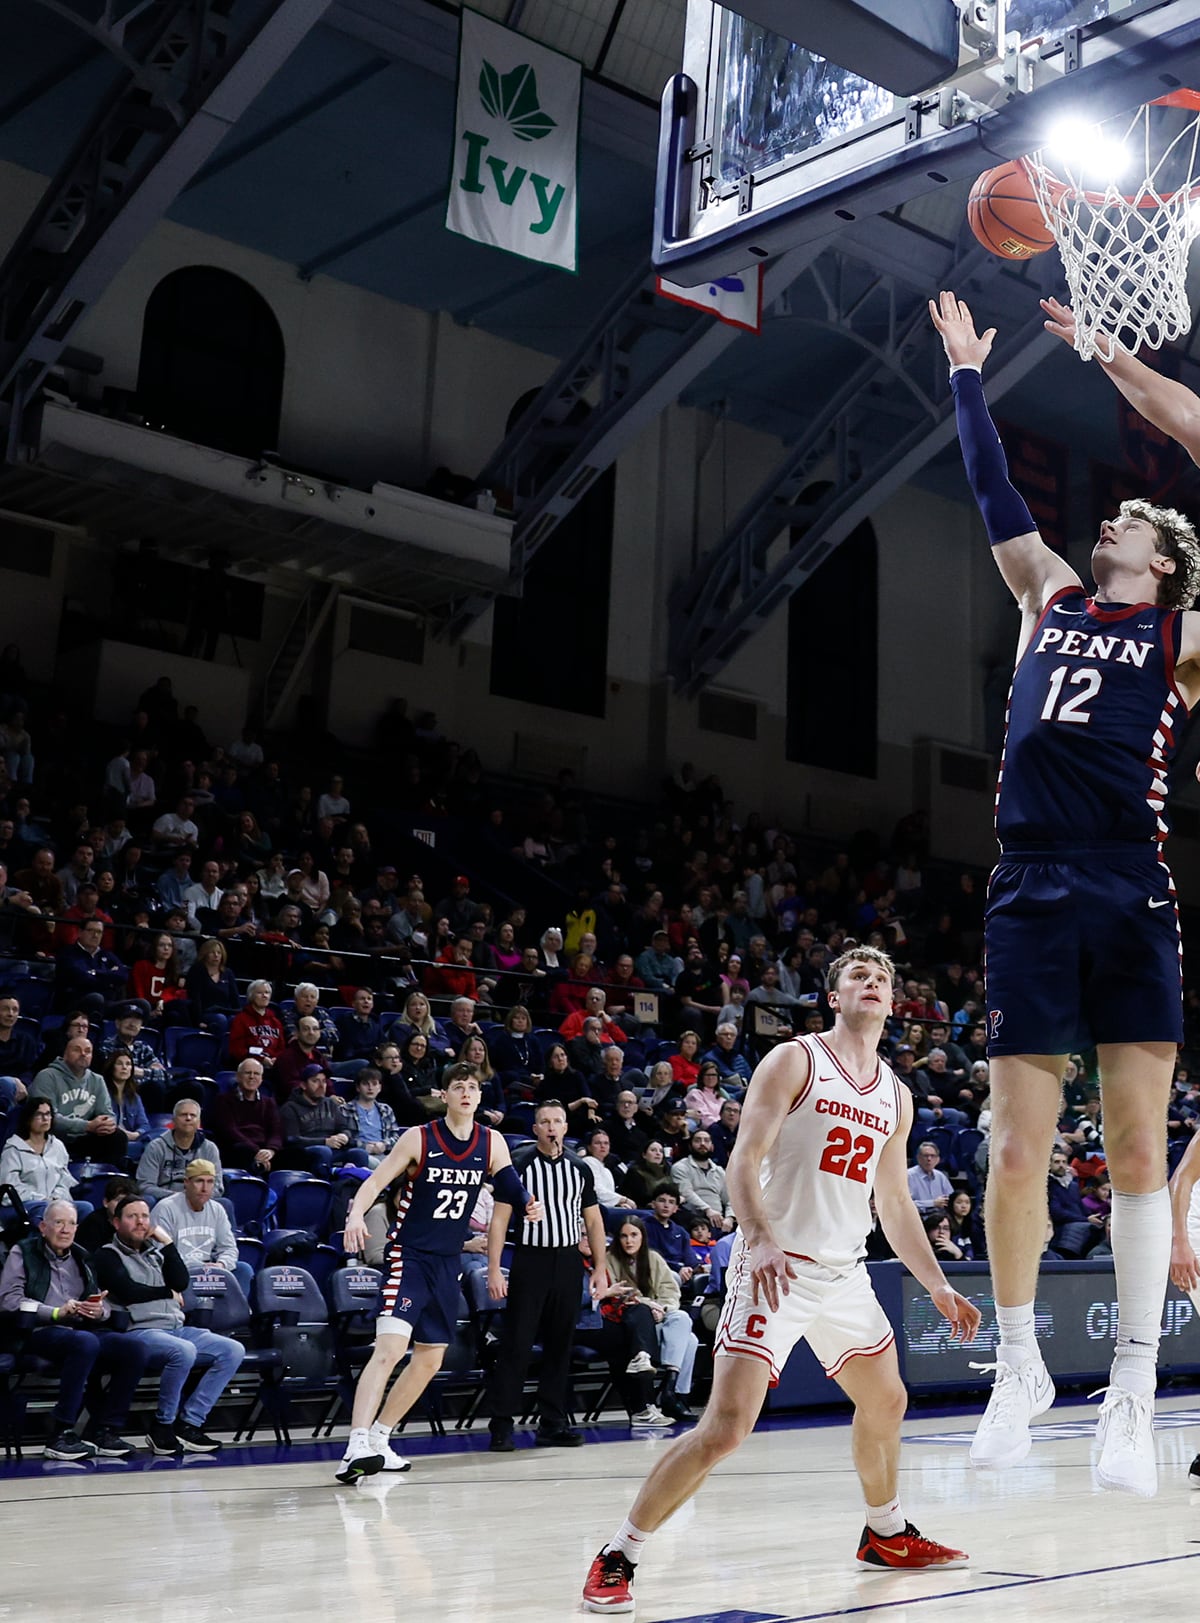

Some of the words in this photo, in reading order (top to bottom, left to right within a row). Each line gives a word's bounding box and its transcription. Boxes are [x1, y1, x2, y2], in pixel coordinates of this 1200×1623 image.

[461, 131, 566, 234] Ivy
[1034, 627, 1154, 669] PENN
[1040, 666, 1103, 724] 12
[150, 976, 166, 998] C
[639, 1002, 654, 1012] 114
[61, 1087, 96, 1106] DIVINE
[815, 1098, 890, 1136] CORNELL
[819, 1126, 875, 1184] 22
[426, 1167, 483, 1185] PENN
[433, 1189, 468, 1219] 23
[745, 1314, 768, 1339] C
[1086, 1300, 1193, 1339] GUP
